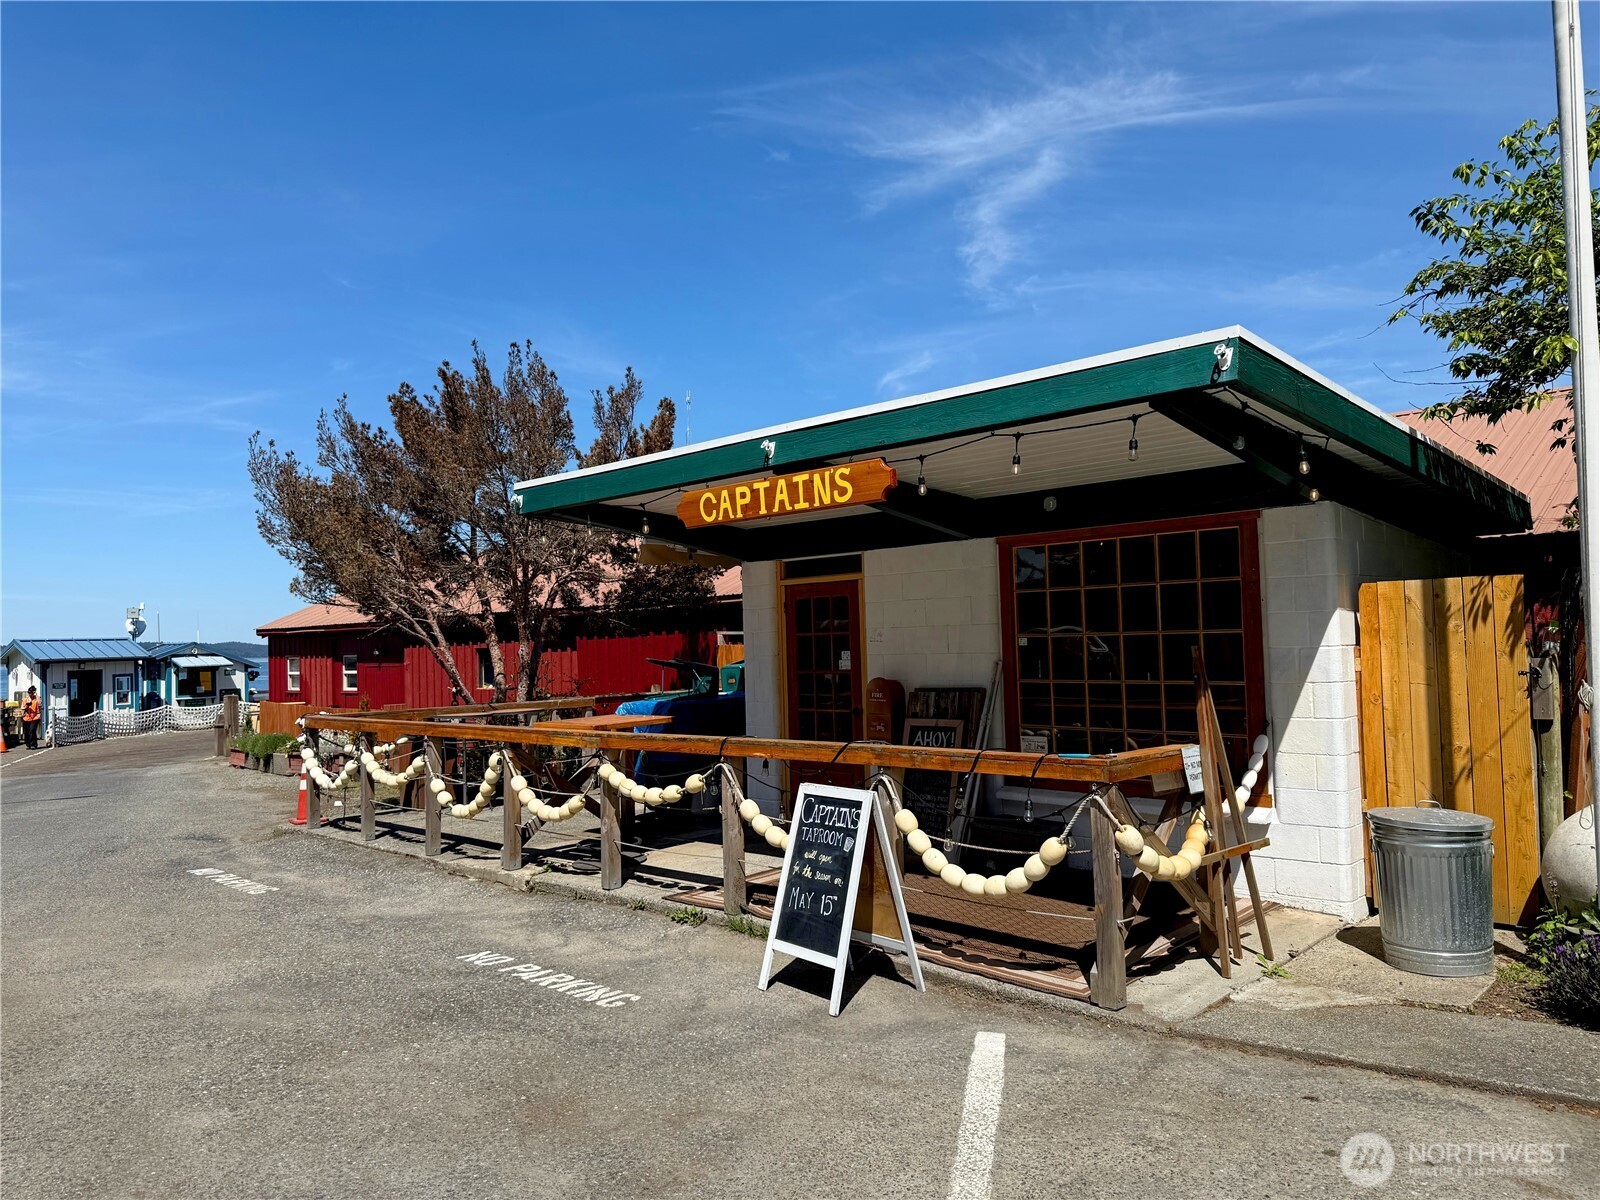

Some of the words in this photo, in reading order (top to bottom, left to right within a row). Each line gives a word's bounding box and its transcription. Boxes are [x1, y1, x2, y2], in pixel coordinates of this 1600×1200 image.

[700, 467, 853, 522] CAPTAIN'S
[912, 730, 955, 748] AHOY!
[801, 797, 861, 829] CAPTAIN'S
[801, 827, 844, 846] TAPROOM
[804, 849, 818, 860] will
[818, 854, 832, 865] open
[801, 864, 813, 879] the
[814, 870, 832, 883] season
[456, 950, 515, 966] NO
[498, 963, 642, 1008] PARKING
